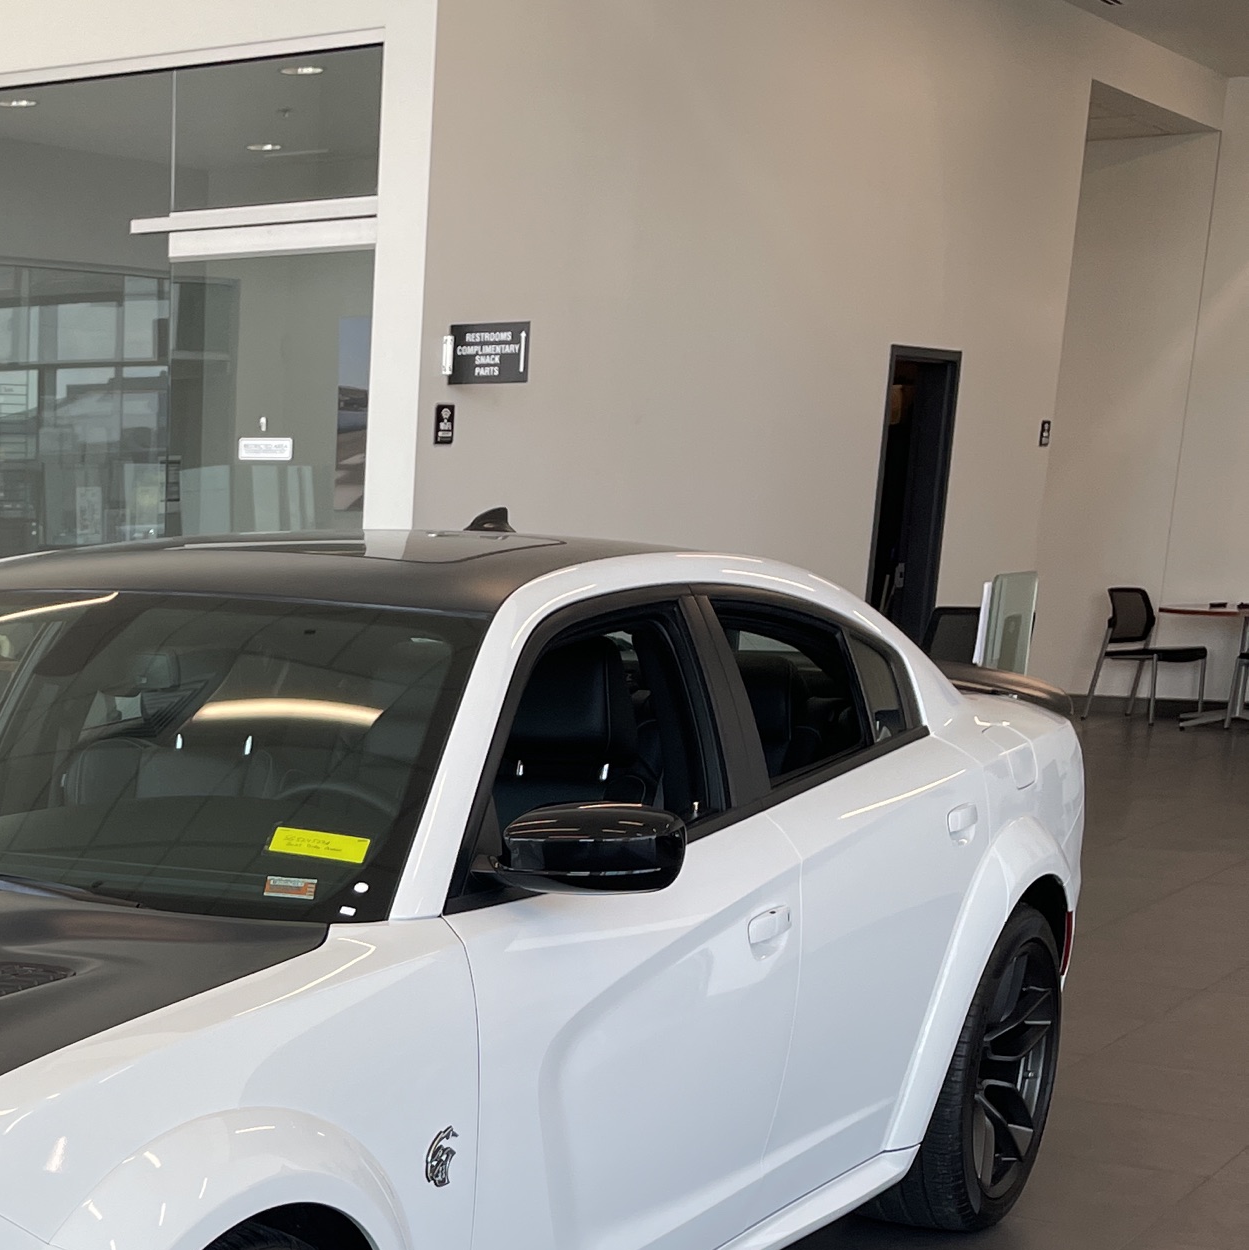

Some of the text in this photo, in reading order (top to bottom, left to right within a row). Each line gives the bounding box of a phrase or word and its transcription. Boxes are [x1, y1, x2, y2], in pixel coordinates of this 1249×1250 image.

[465, 331, 512, 342] RESTROOMS
[456, 343, 520, 356] COMPLIMENTARY
[474, 354, 501, 365] SNACK
[474, 366, 500, 376] PARTS
